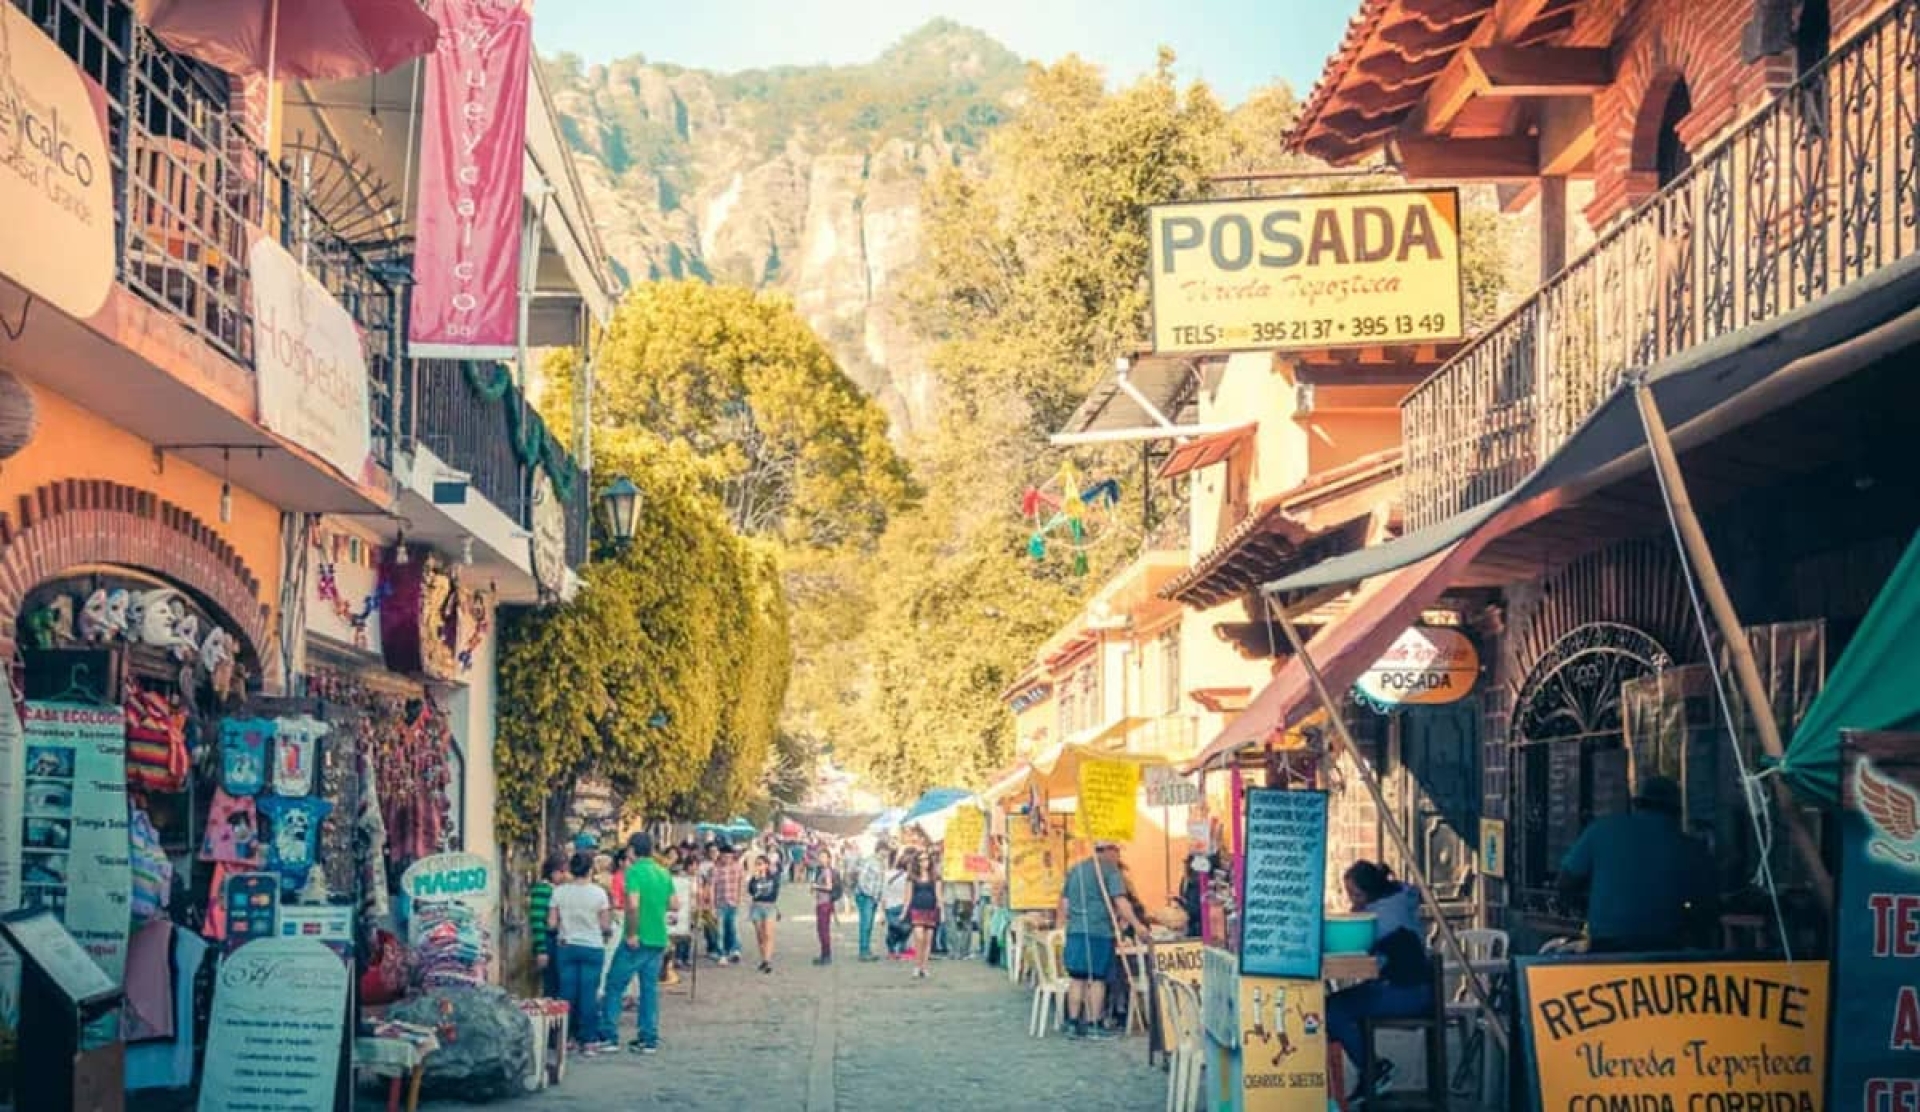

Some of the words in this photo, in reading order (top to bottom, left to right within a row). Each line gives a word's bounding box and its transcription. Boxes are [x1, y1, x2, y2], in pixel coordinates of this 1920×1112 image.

[1161, 204, 1443, 274] POSADA
[1252, 321, 1286, 342] 395
[1314, 318, 1333, 339] 37
[1351, 317, 1388, 337] 395
[1395, 315, 1413, 334] 13
[1418, 313, 1446, 333] 49
[1380, 672, 1453, 690] POSADA
[1539, 973, 1811, 1041] RESTAURANTE
[1576, 1042, 1676, 1079] Vereda
[1684, 1040, 1813, 1088] Tepozteca
